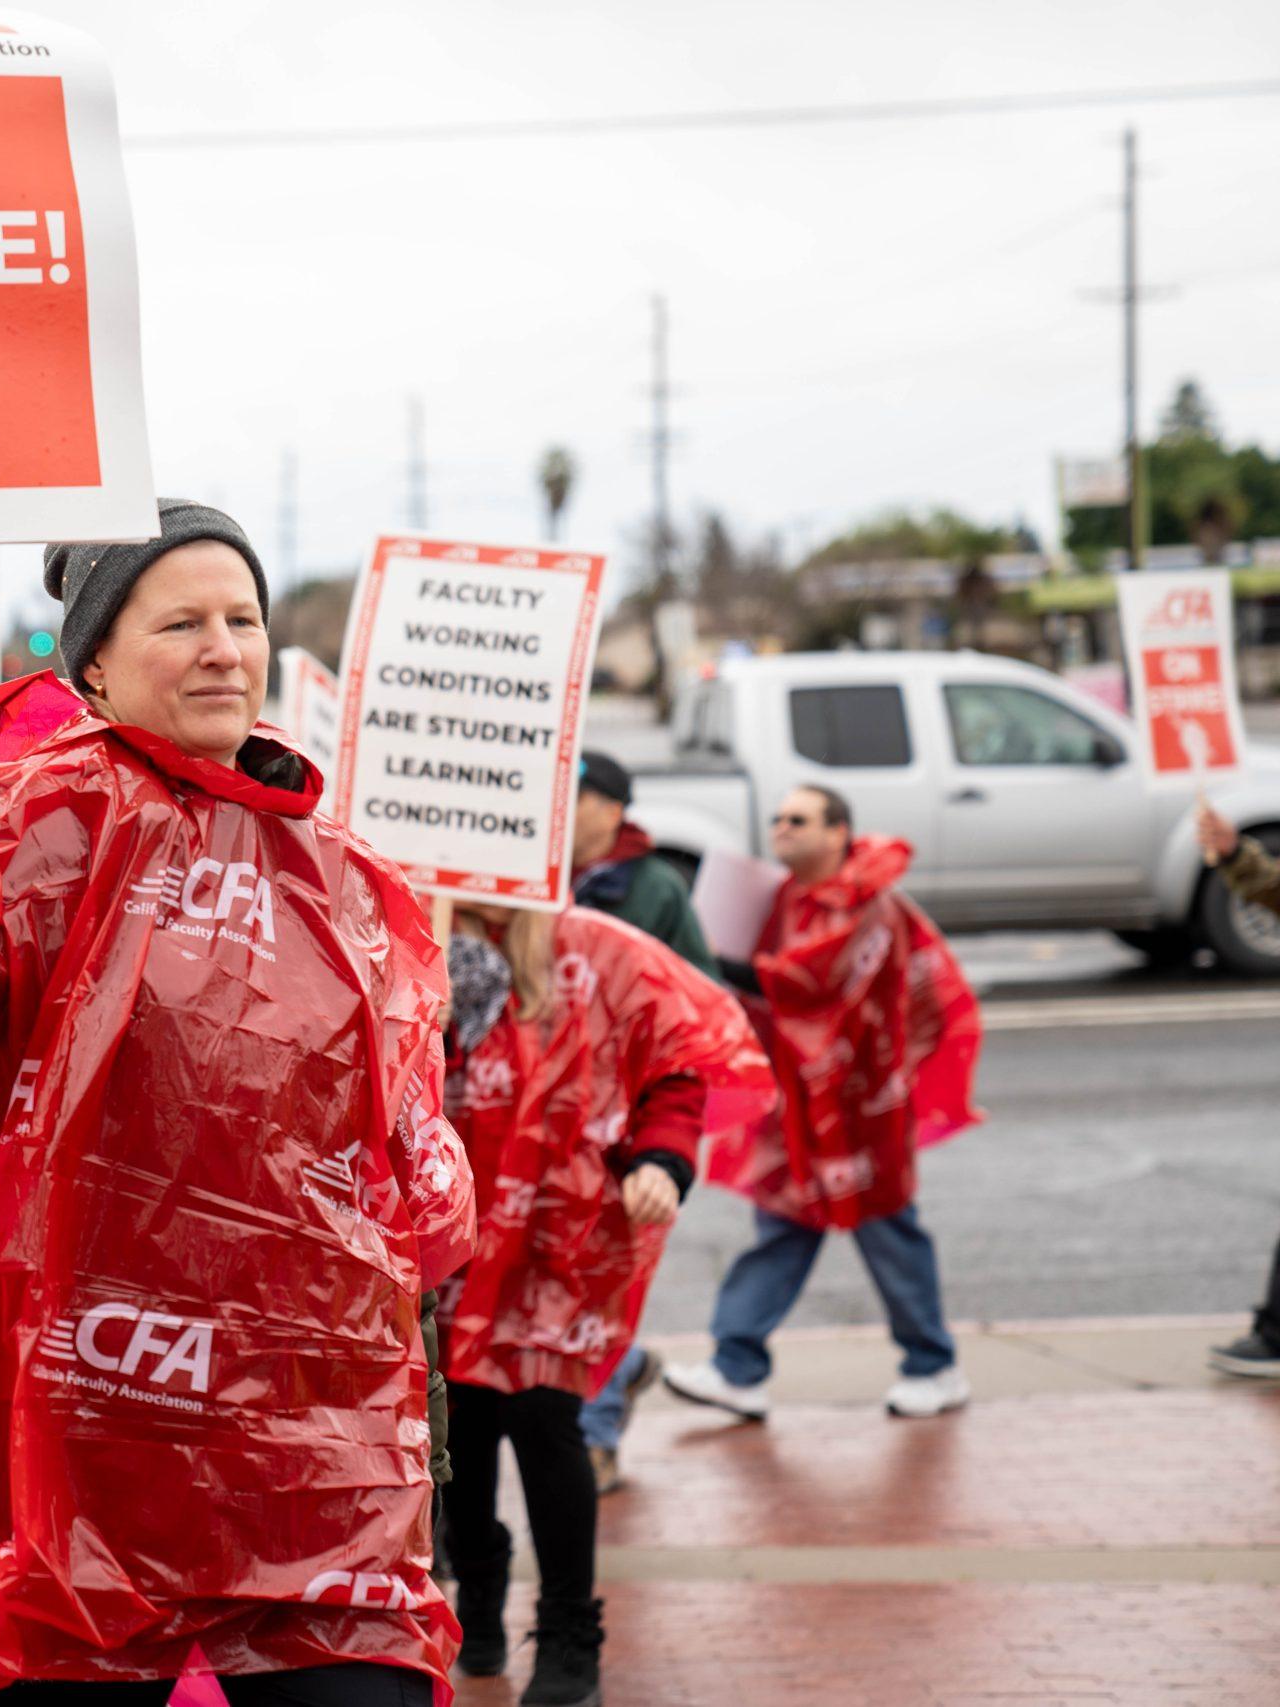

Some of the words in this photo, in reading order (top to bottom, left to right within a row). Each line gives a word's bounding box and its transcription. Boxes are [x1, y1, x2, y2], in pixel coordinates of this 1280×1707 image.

[418, 578, 545, 609] FACULTY
[404, 623, 540, 656] WORKING
[378, 664, 552, 702] CONDITIONS
[365, 708, 417, 734] ARE
[428, 714, 556, 748] STUDENT
[384, 755, 525, 791] LEARNING
[365, 798, 538, 839] CONDITIONS
[181, 856, 276, 943] CFA
[166, 917, 215, 941] Faculty
[75, 1301, 213, 1394] CFA
[66, 1370, 117, 1397] Faculty
[119, 1383, 204, 1413] Association
